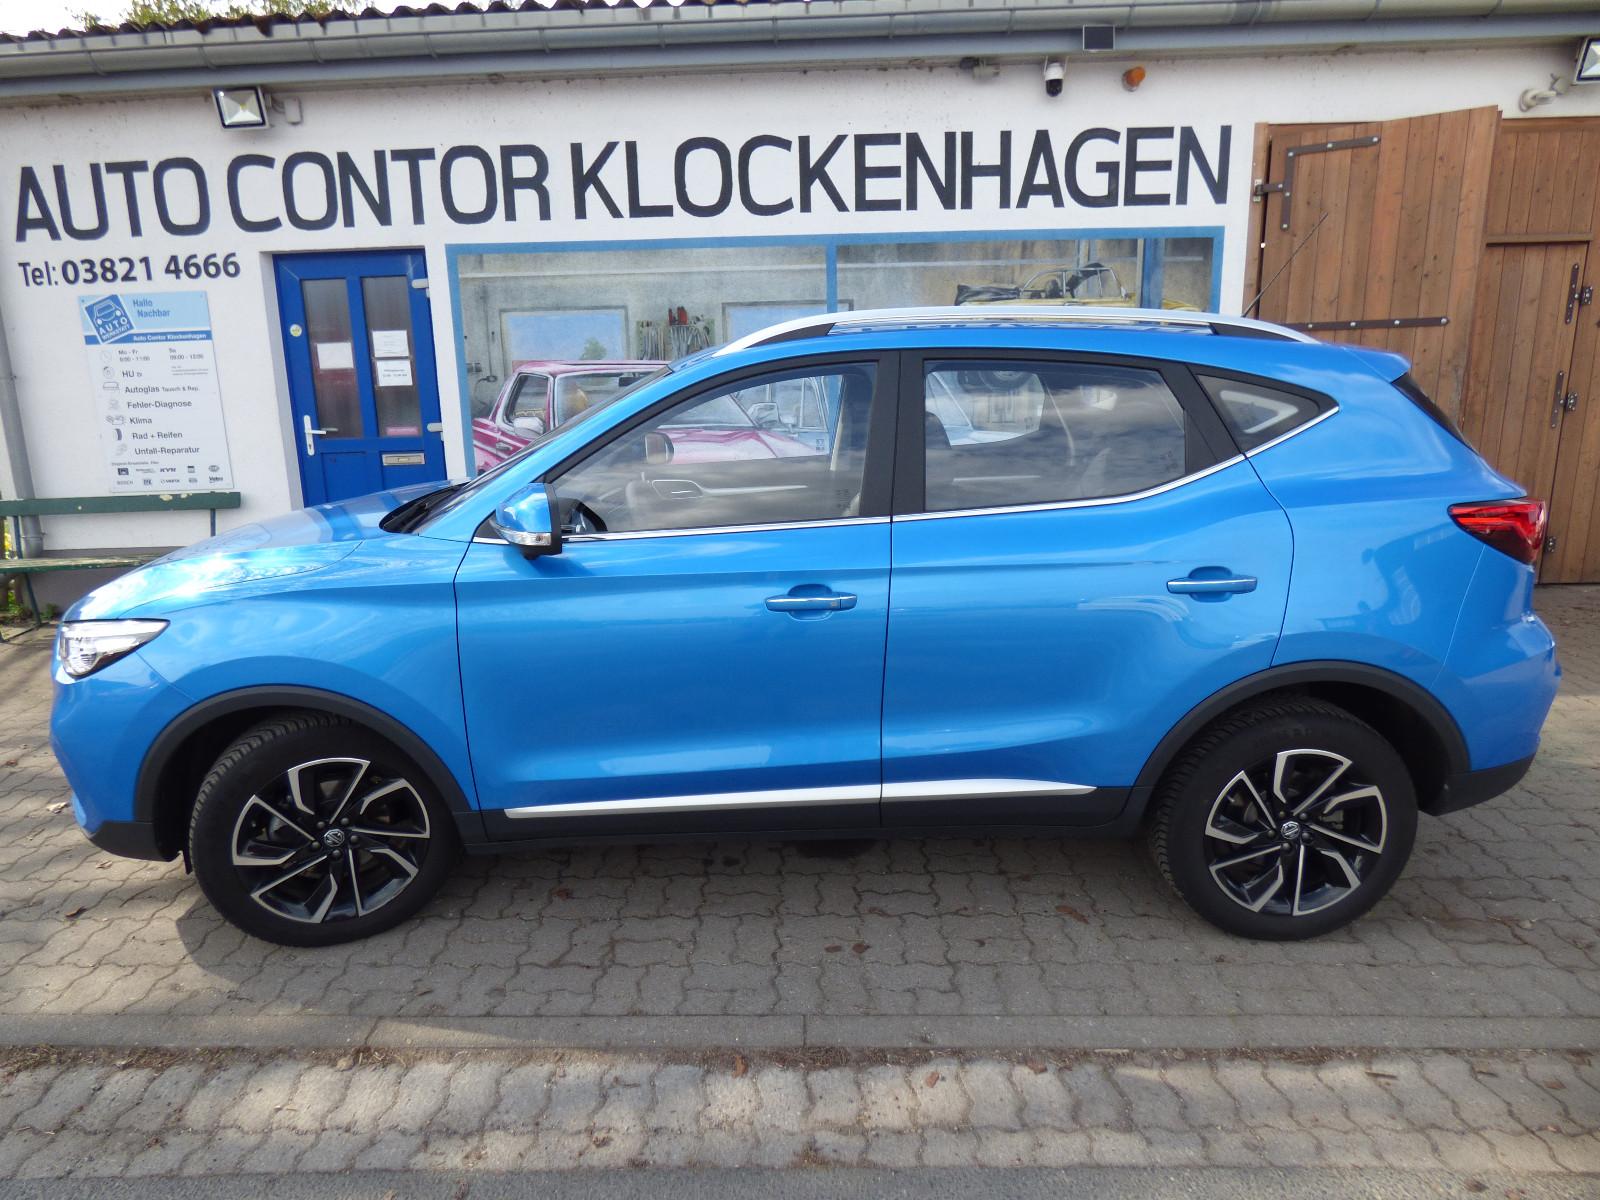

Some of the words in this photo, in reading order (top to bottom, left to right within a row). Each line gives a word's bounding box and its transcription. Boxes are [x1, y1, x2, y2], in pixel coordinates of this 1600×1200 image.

[15, 156, 211, 242] AUTO
[227, 143, 552, 233] CONTOR
[570, 125, 1231, 220] KLOCKENHAGEN
[164, 252, 241, 280] 4666
[133, 299, 153, 309] Hallo
[137, 309, 170, 318] Nachbar
[99, 316, 128, 336] AUTO
[122, 370, 135, 378] HU
[125, 386, 160, 394] Autoglas
[127, 401, 192, 409] Fehler-Diagnose
[132, 432, 148, 440] Rad
[157, 431, 183, 439] Reifen
[134, 446, 200, 455] Unfall-Reparatur
